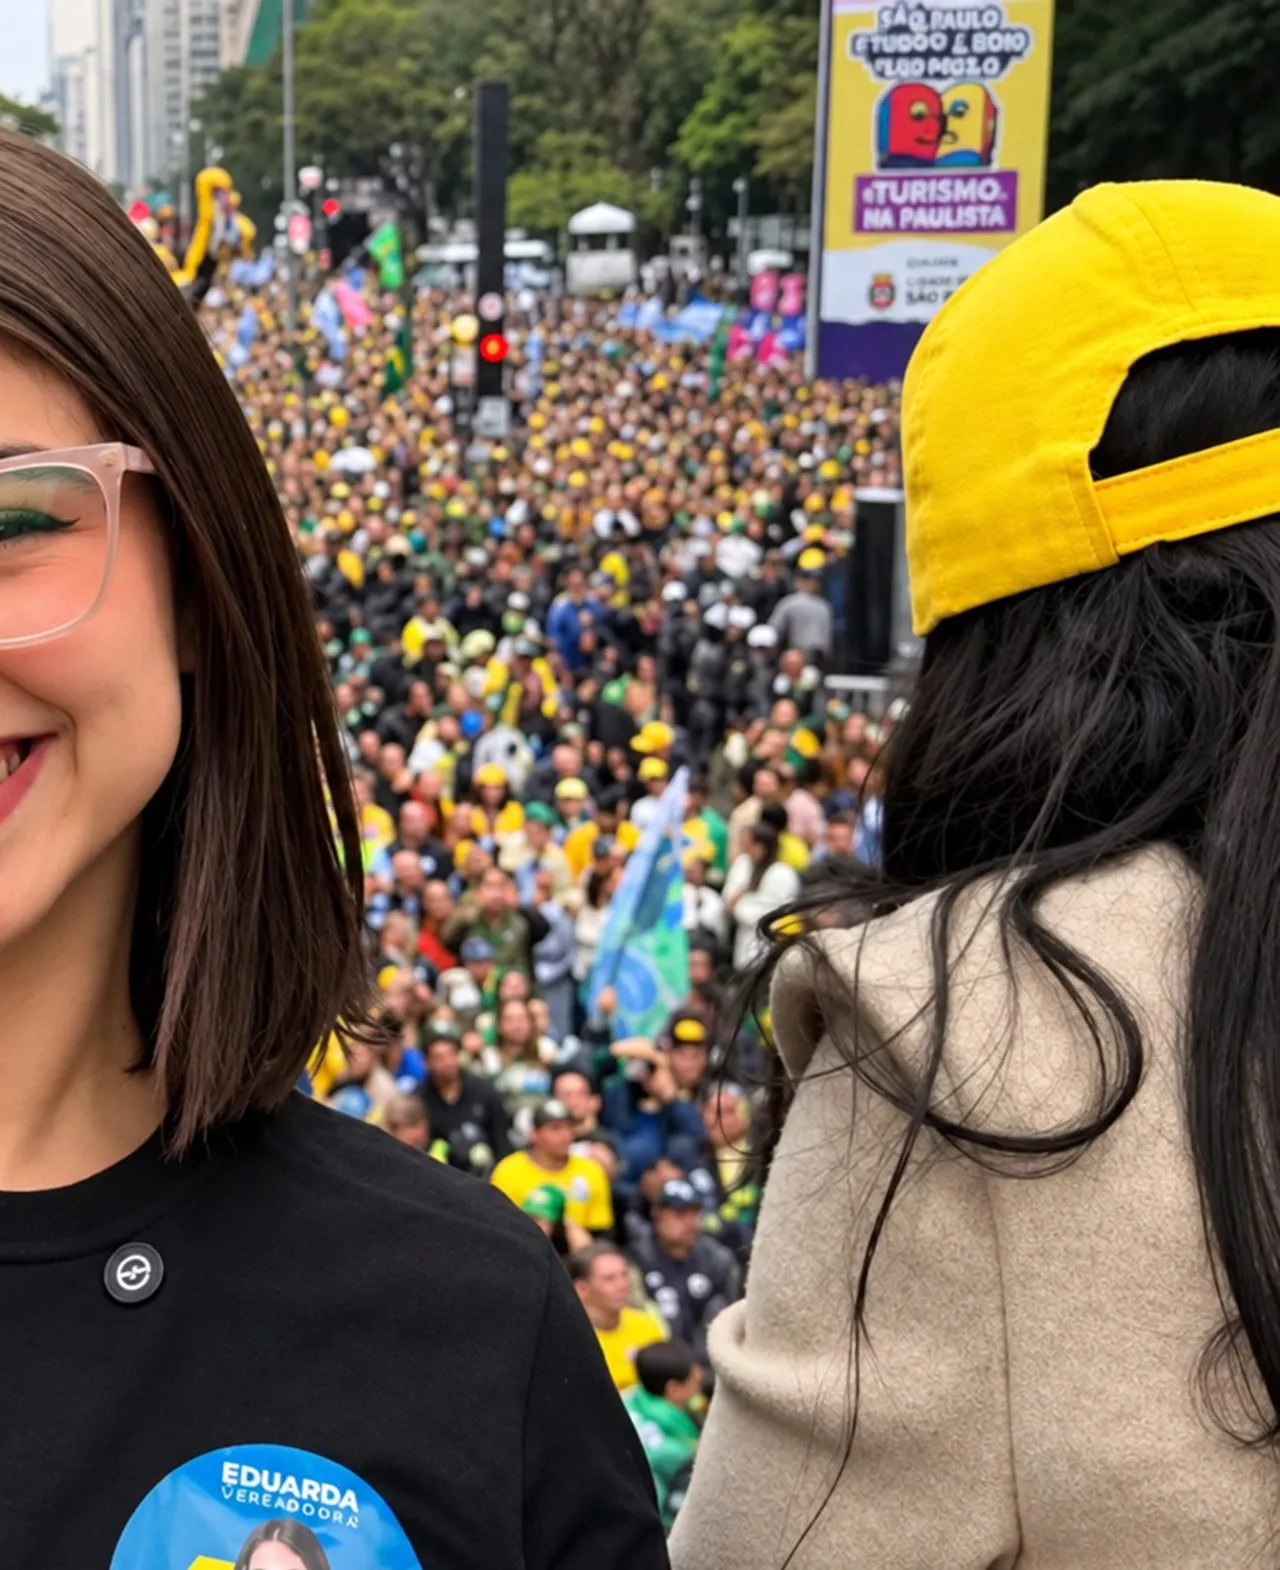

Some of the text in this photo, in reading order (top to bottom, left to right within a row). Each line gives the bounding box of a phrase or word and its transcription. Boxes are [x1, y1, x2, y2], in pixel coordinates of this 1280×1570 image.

[930, 9, 1000, 30] PAULO
[862, 205, 1007, 230] NA PAULISTA
[221, 1461, 360, 1514] EDUARDA
